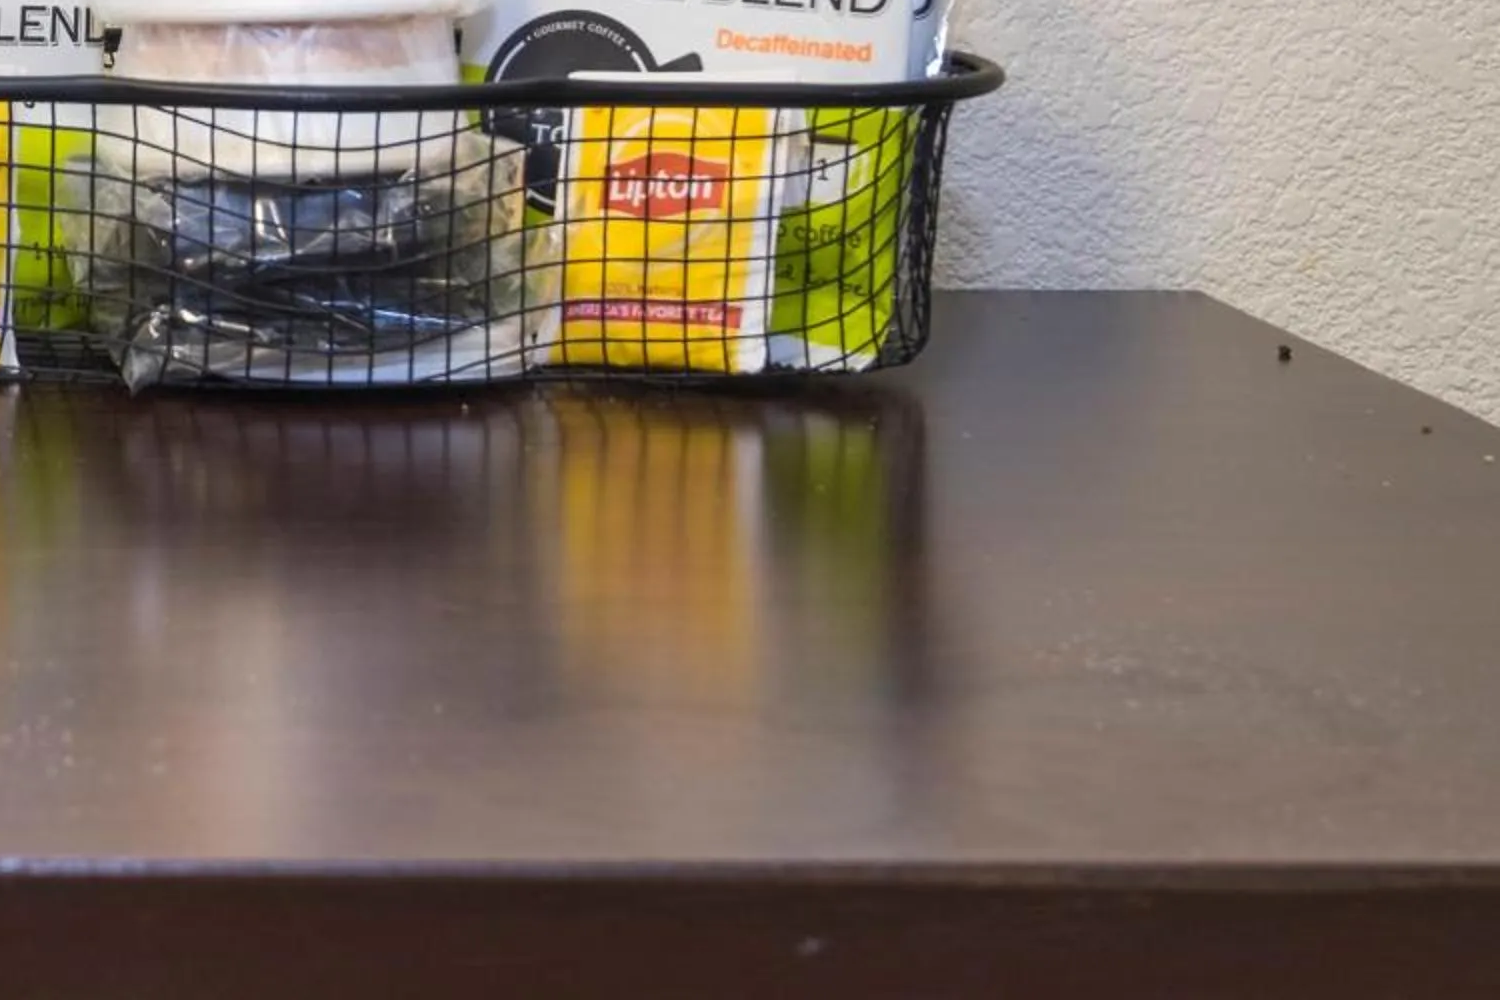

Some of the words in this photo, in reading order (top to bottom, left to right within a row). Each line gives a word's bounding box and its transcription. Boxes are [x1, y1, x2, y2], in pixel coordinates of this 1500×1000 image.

[716, 28, 874, 63] Decaffeinated
[609, 167, 715, 208] Lipton
[631, 305, 696, 320] FAVORIE
